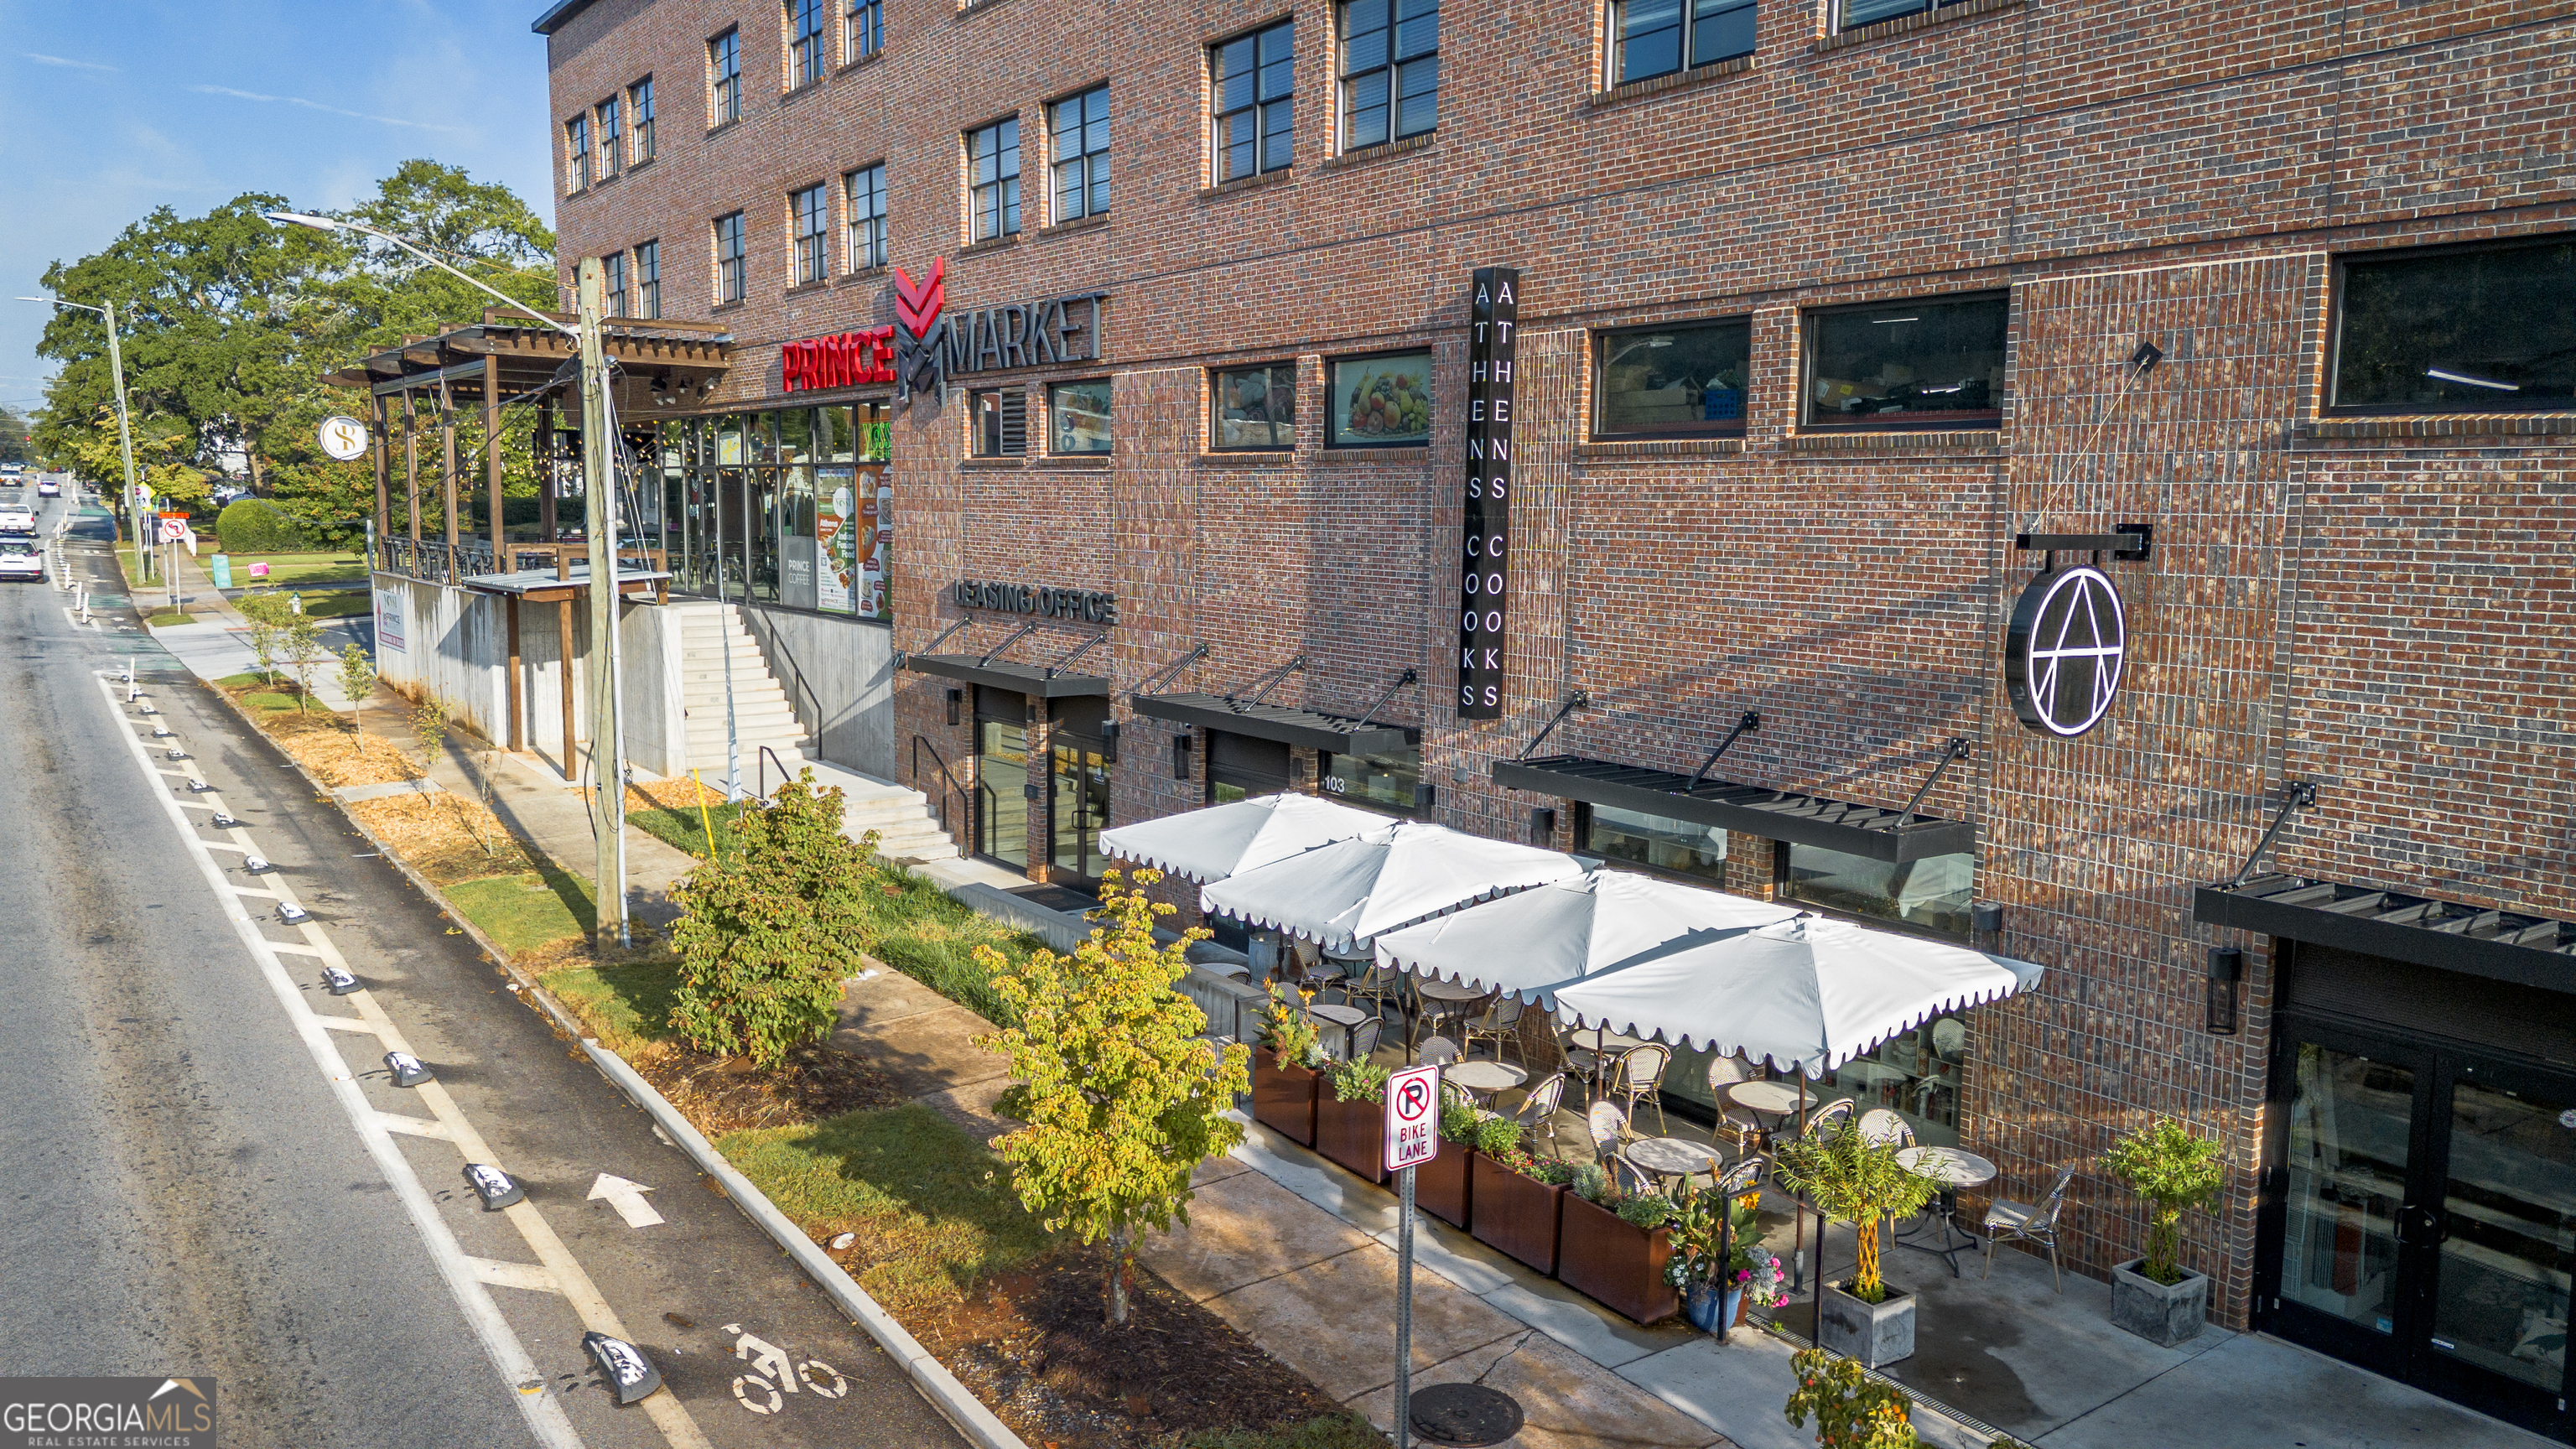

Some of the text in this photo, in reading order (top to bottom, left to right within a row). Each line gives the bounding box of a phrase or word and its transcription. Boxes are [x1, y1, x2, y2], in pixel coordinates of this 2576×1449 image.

[782, 325, 896, 392] PRINCE
[948, 290, 1111, 374] MARKET
[1462, 283, 1489, 705] ATHENS COOKS
[1484, 282, 1514, 706] ATHENS COOKS
[842, 550, 854, 558] Food
[788, 559, 810, 572] PRINCE
[788, 574, 810, 585] COFFEE
[954, 579, 1119, 624] LEASING OFFICE
[1325, 775, 1345, 793] 103
[1400, 1123, 1426, 1142] BIKE
[1399, 1141, 1427, 1161] LANE
